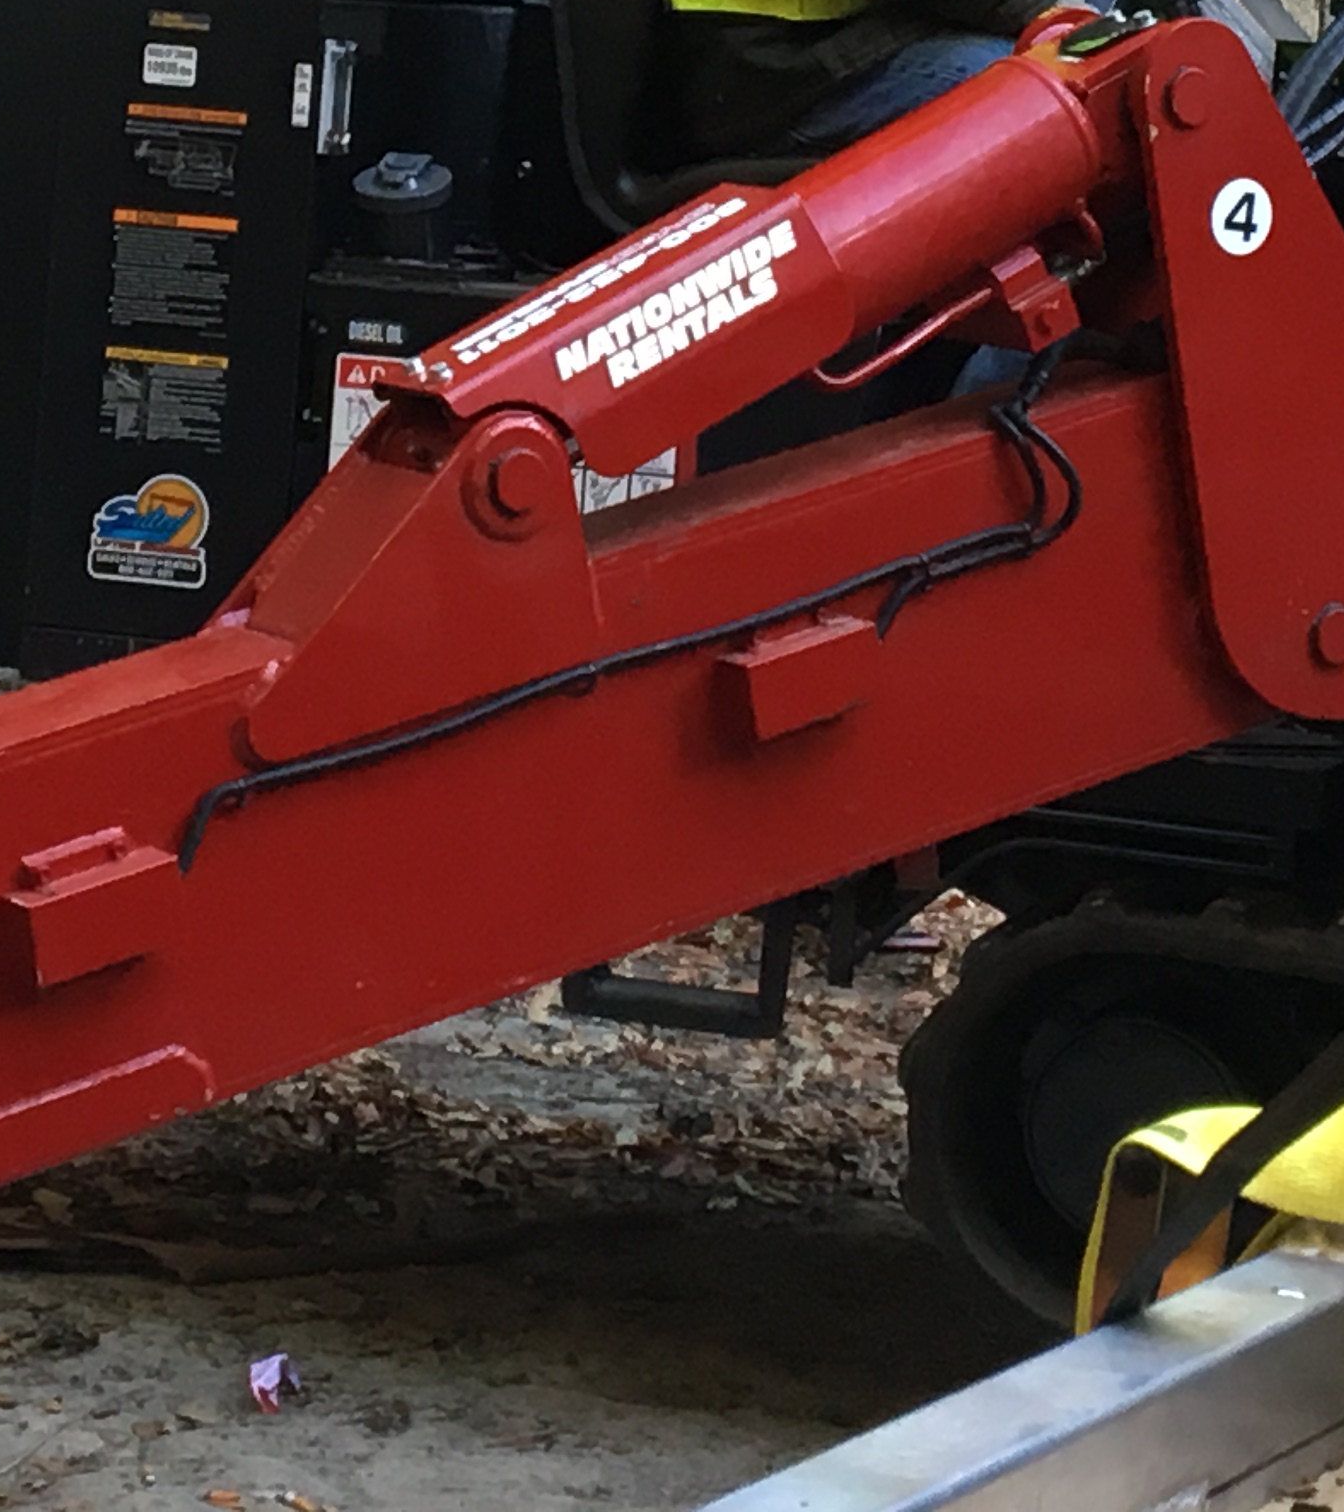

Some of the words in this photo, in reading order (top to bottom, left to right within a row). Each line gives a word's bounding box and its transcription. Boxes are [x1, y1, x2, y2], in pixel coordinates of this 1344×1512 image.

[1223, 191, 1258, 242] 4
[348, 320, 384, 343] DIESEL
[553, 218, 798, 382] NATIONWIDE
[605, 265, 779, 388] RENTALS
